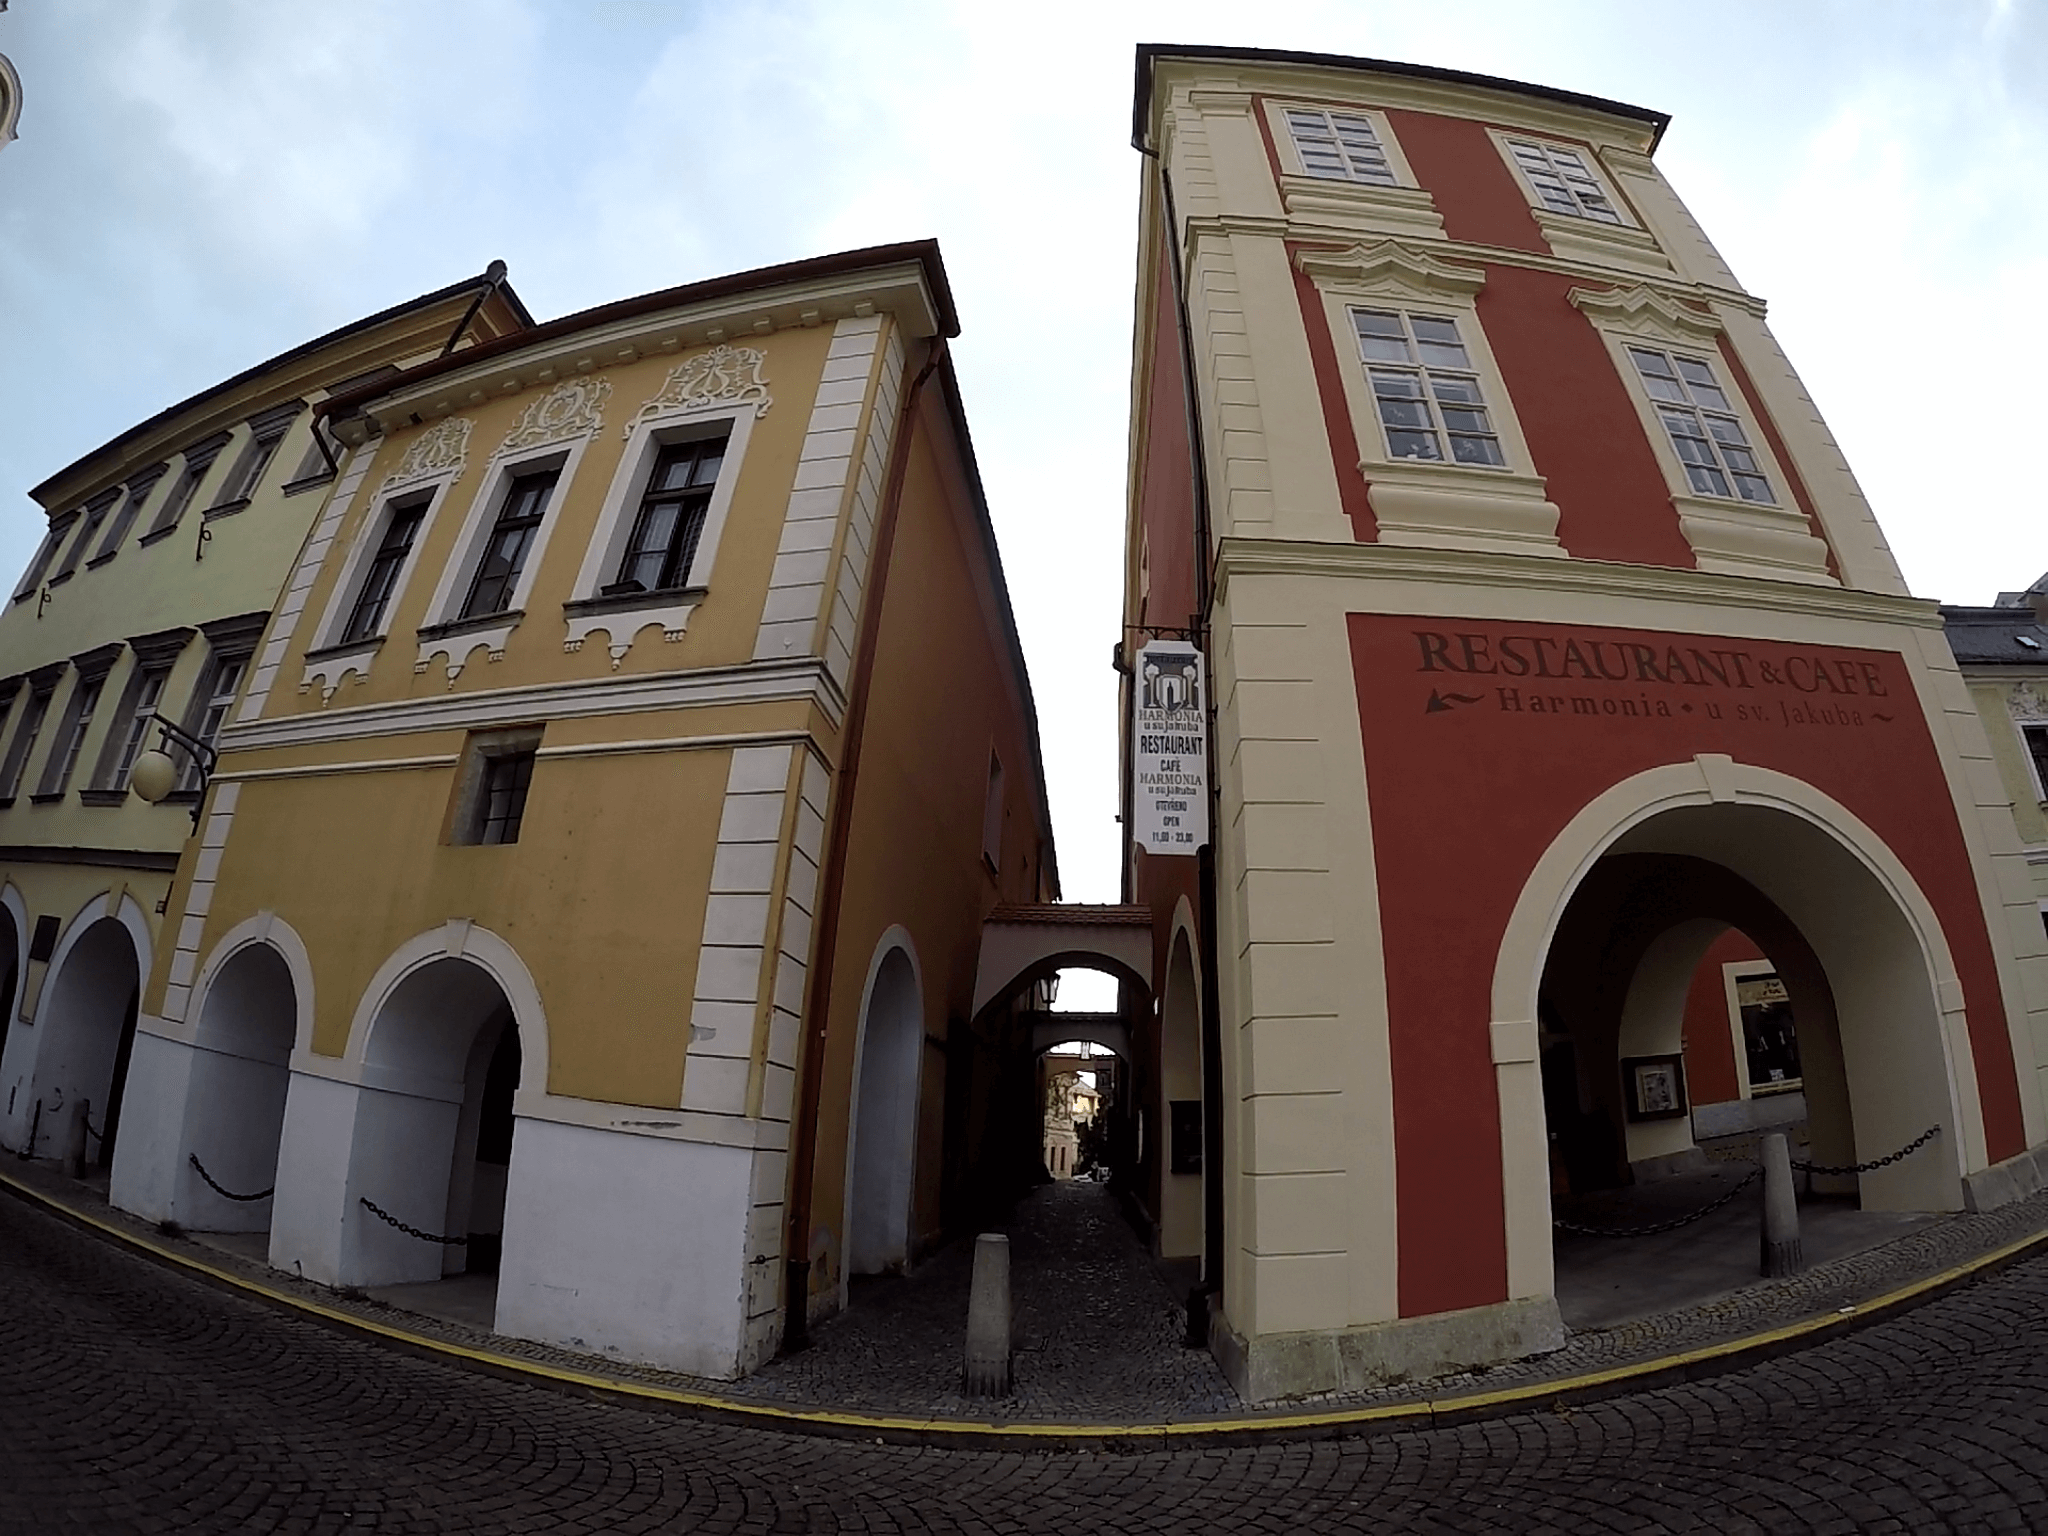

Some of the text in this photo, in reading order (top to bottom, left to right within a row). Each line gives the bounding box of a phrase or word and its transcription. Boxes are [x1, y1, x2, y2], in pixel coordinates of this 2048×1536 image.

[1411, 631, 1755, 689] RESTAURANT
[1784, 656, 1888, 697] CAFE
[1138, 709, 1204, 723] HARMONIA
[1495, 687, 1864, 728] Harmonia u sv. Jakuba
[1140, 735, 1203, 756] RESTAURANT
[1139, 773, 1203, 786] HARMONIA
[1163, 814, 1180, 827] OPEN
